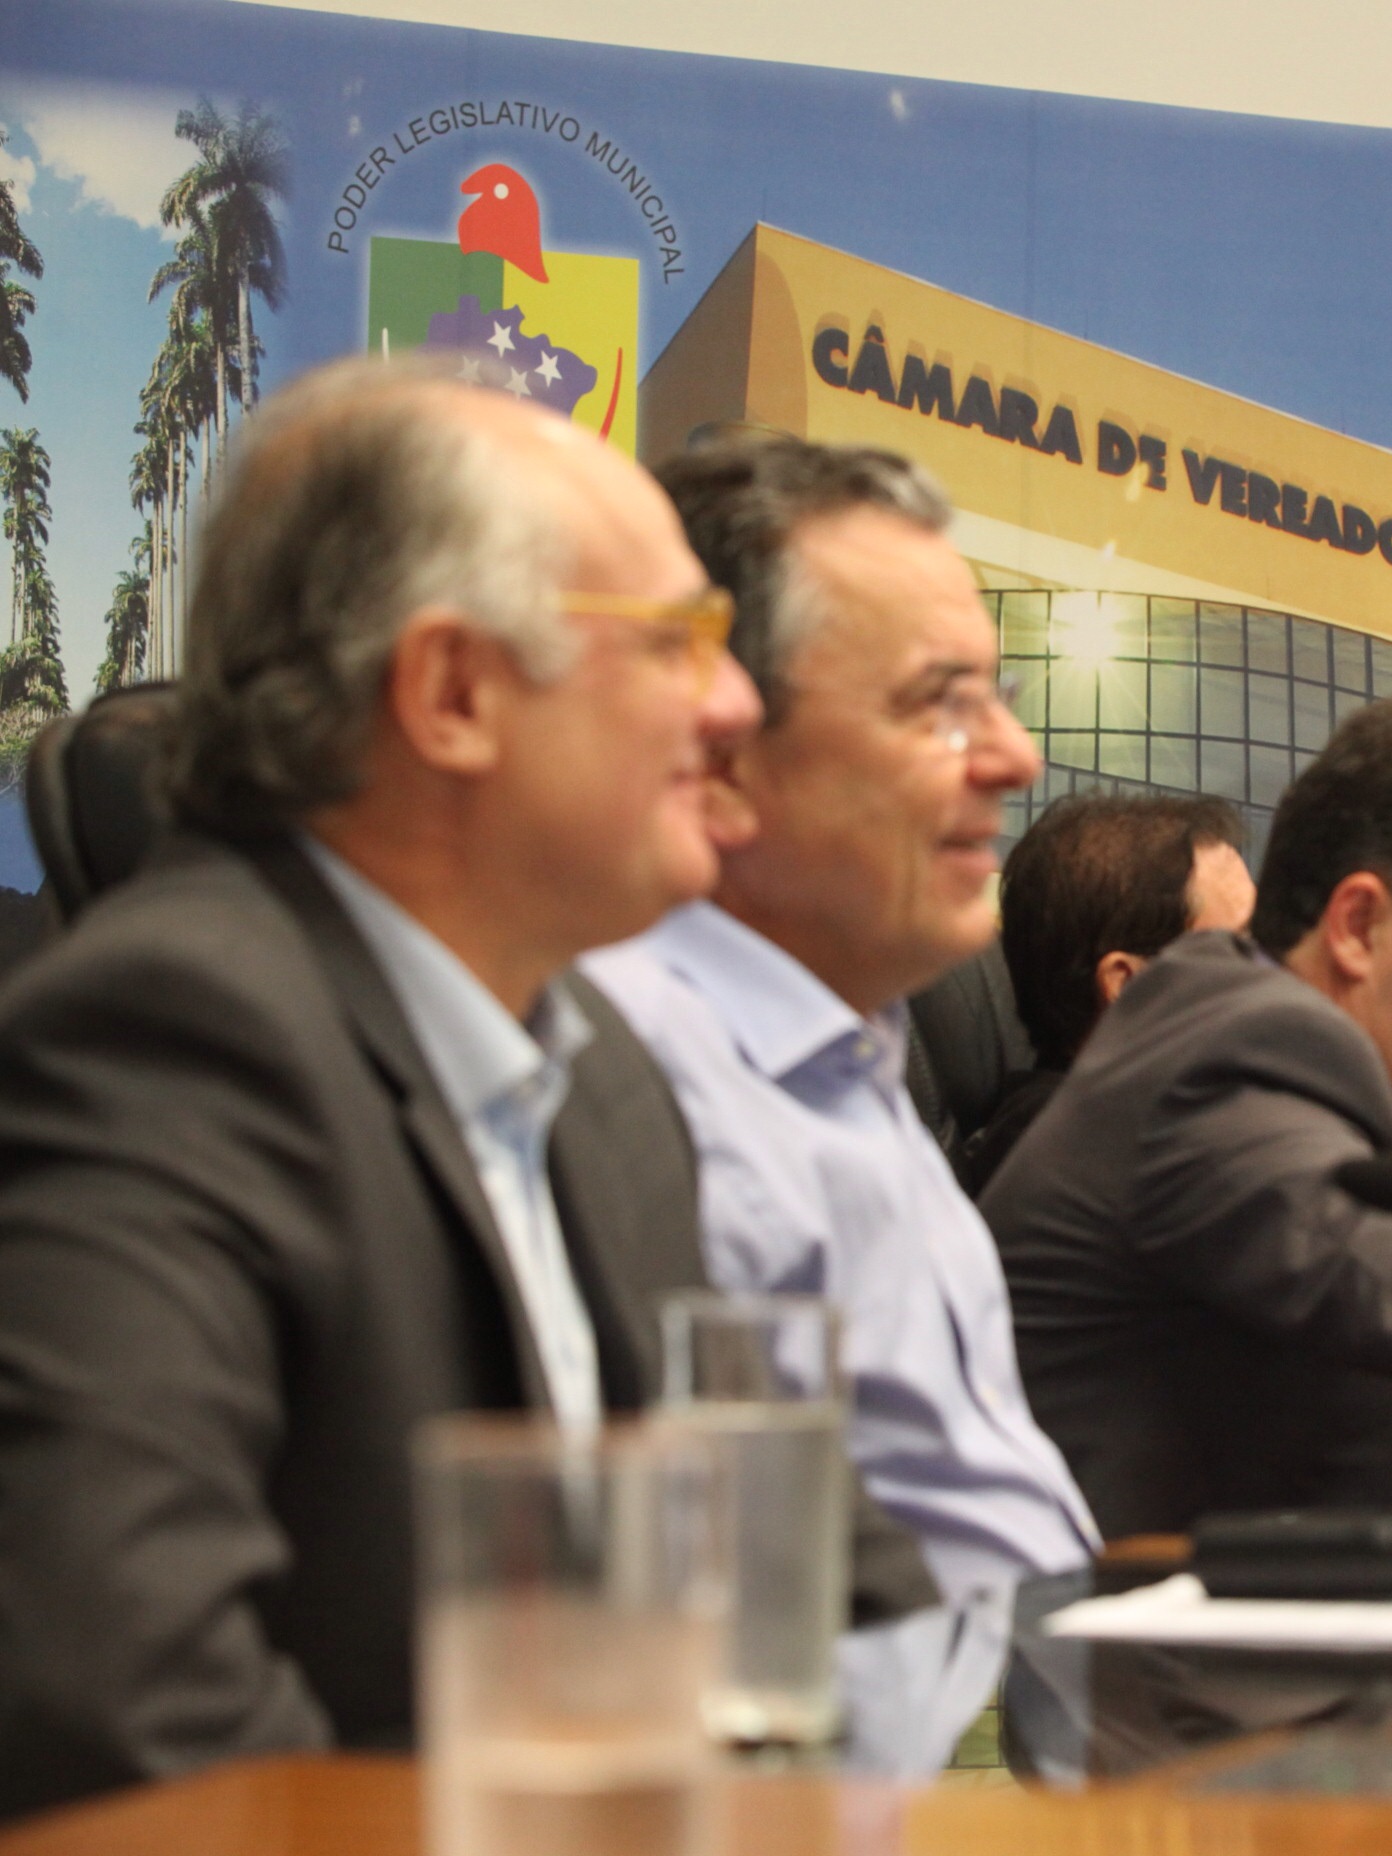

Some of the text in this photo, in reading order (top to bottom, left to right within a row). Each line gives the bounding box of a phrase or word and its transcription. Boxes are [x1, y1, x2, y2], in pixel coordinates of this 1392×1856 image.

[327, 101, 685, 285] PODER LEGISLATIVO MUNICIPAL
[811, 325, 1083, 465] CÂMARA
[1097, 419, 1167, 492] DE
